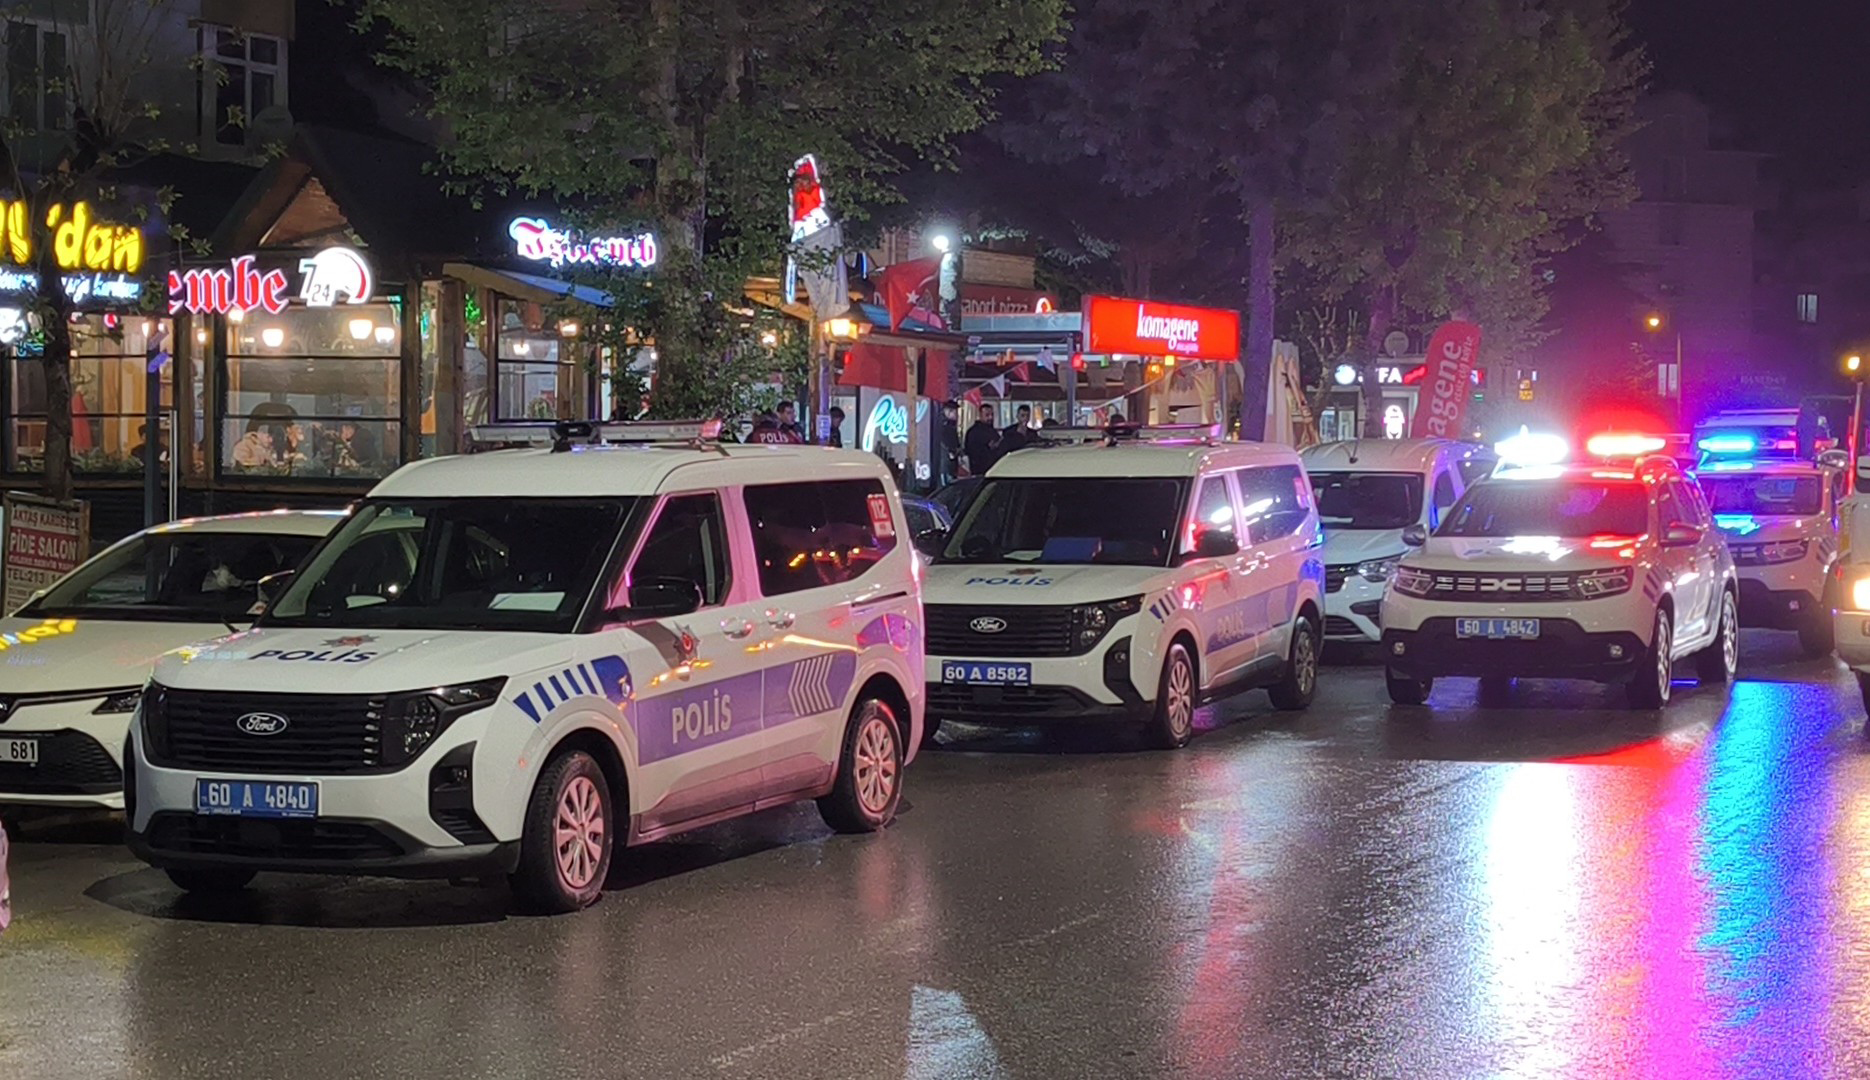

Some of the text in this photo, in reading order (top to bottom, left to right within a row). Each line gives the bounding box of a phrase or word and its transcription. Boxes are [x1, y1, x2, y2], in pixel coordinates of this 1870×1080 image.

[1137, 303, 1199, 350] komagene
[1424, 341, 1463, 438] agene
[9, 529, 36, 554] PİDE
[965, 576, 1054, 586] POLİS
[1464, 620, 1534, 635] 60 A 4842
[248, 649, 379, 663] POLİS
[945, 666, 1027, 681] 60 A 8582
[246, 715, 278, 731] Ford
[671, 688, 732, 744] POLİS
[10, 741, 35, 760] 681
[208, 782, 310, 809] 60 A 4840
